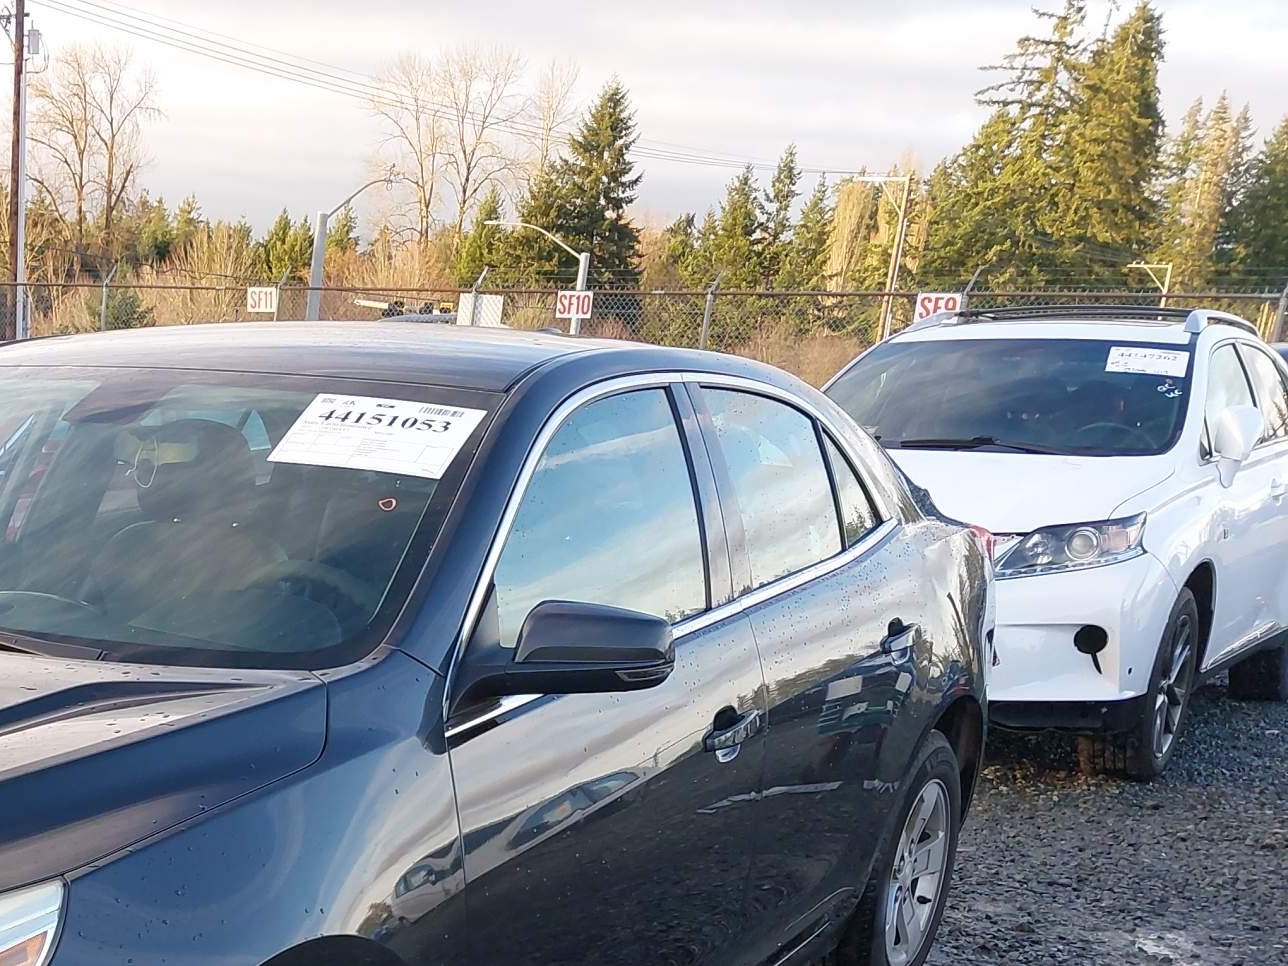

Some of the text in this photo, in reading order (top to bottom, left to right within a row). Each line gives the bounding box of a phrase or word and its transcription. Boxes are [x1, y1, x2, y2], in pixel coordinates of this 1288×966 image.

[250, 290, 273, 309] SF11
[557, 294, 591, 315] SF10
[318, 409, 452, 433] 44151053
